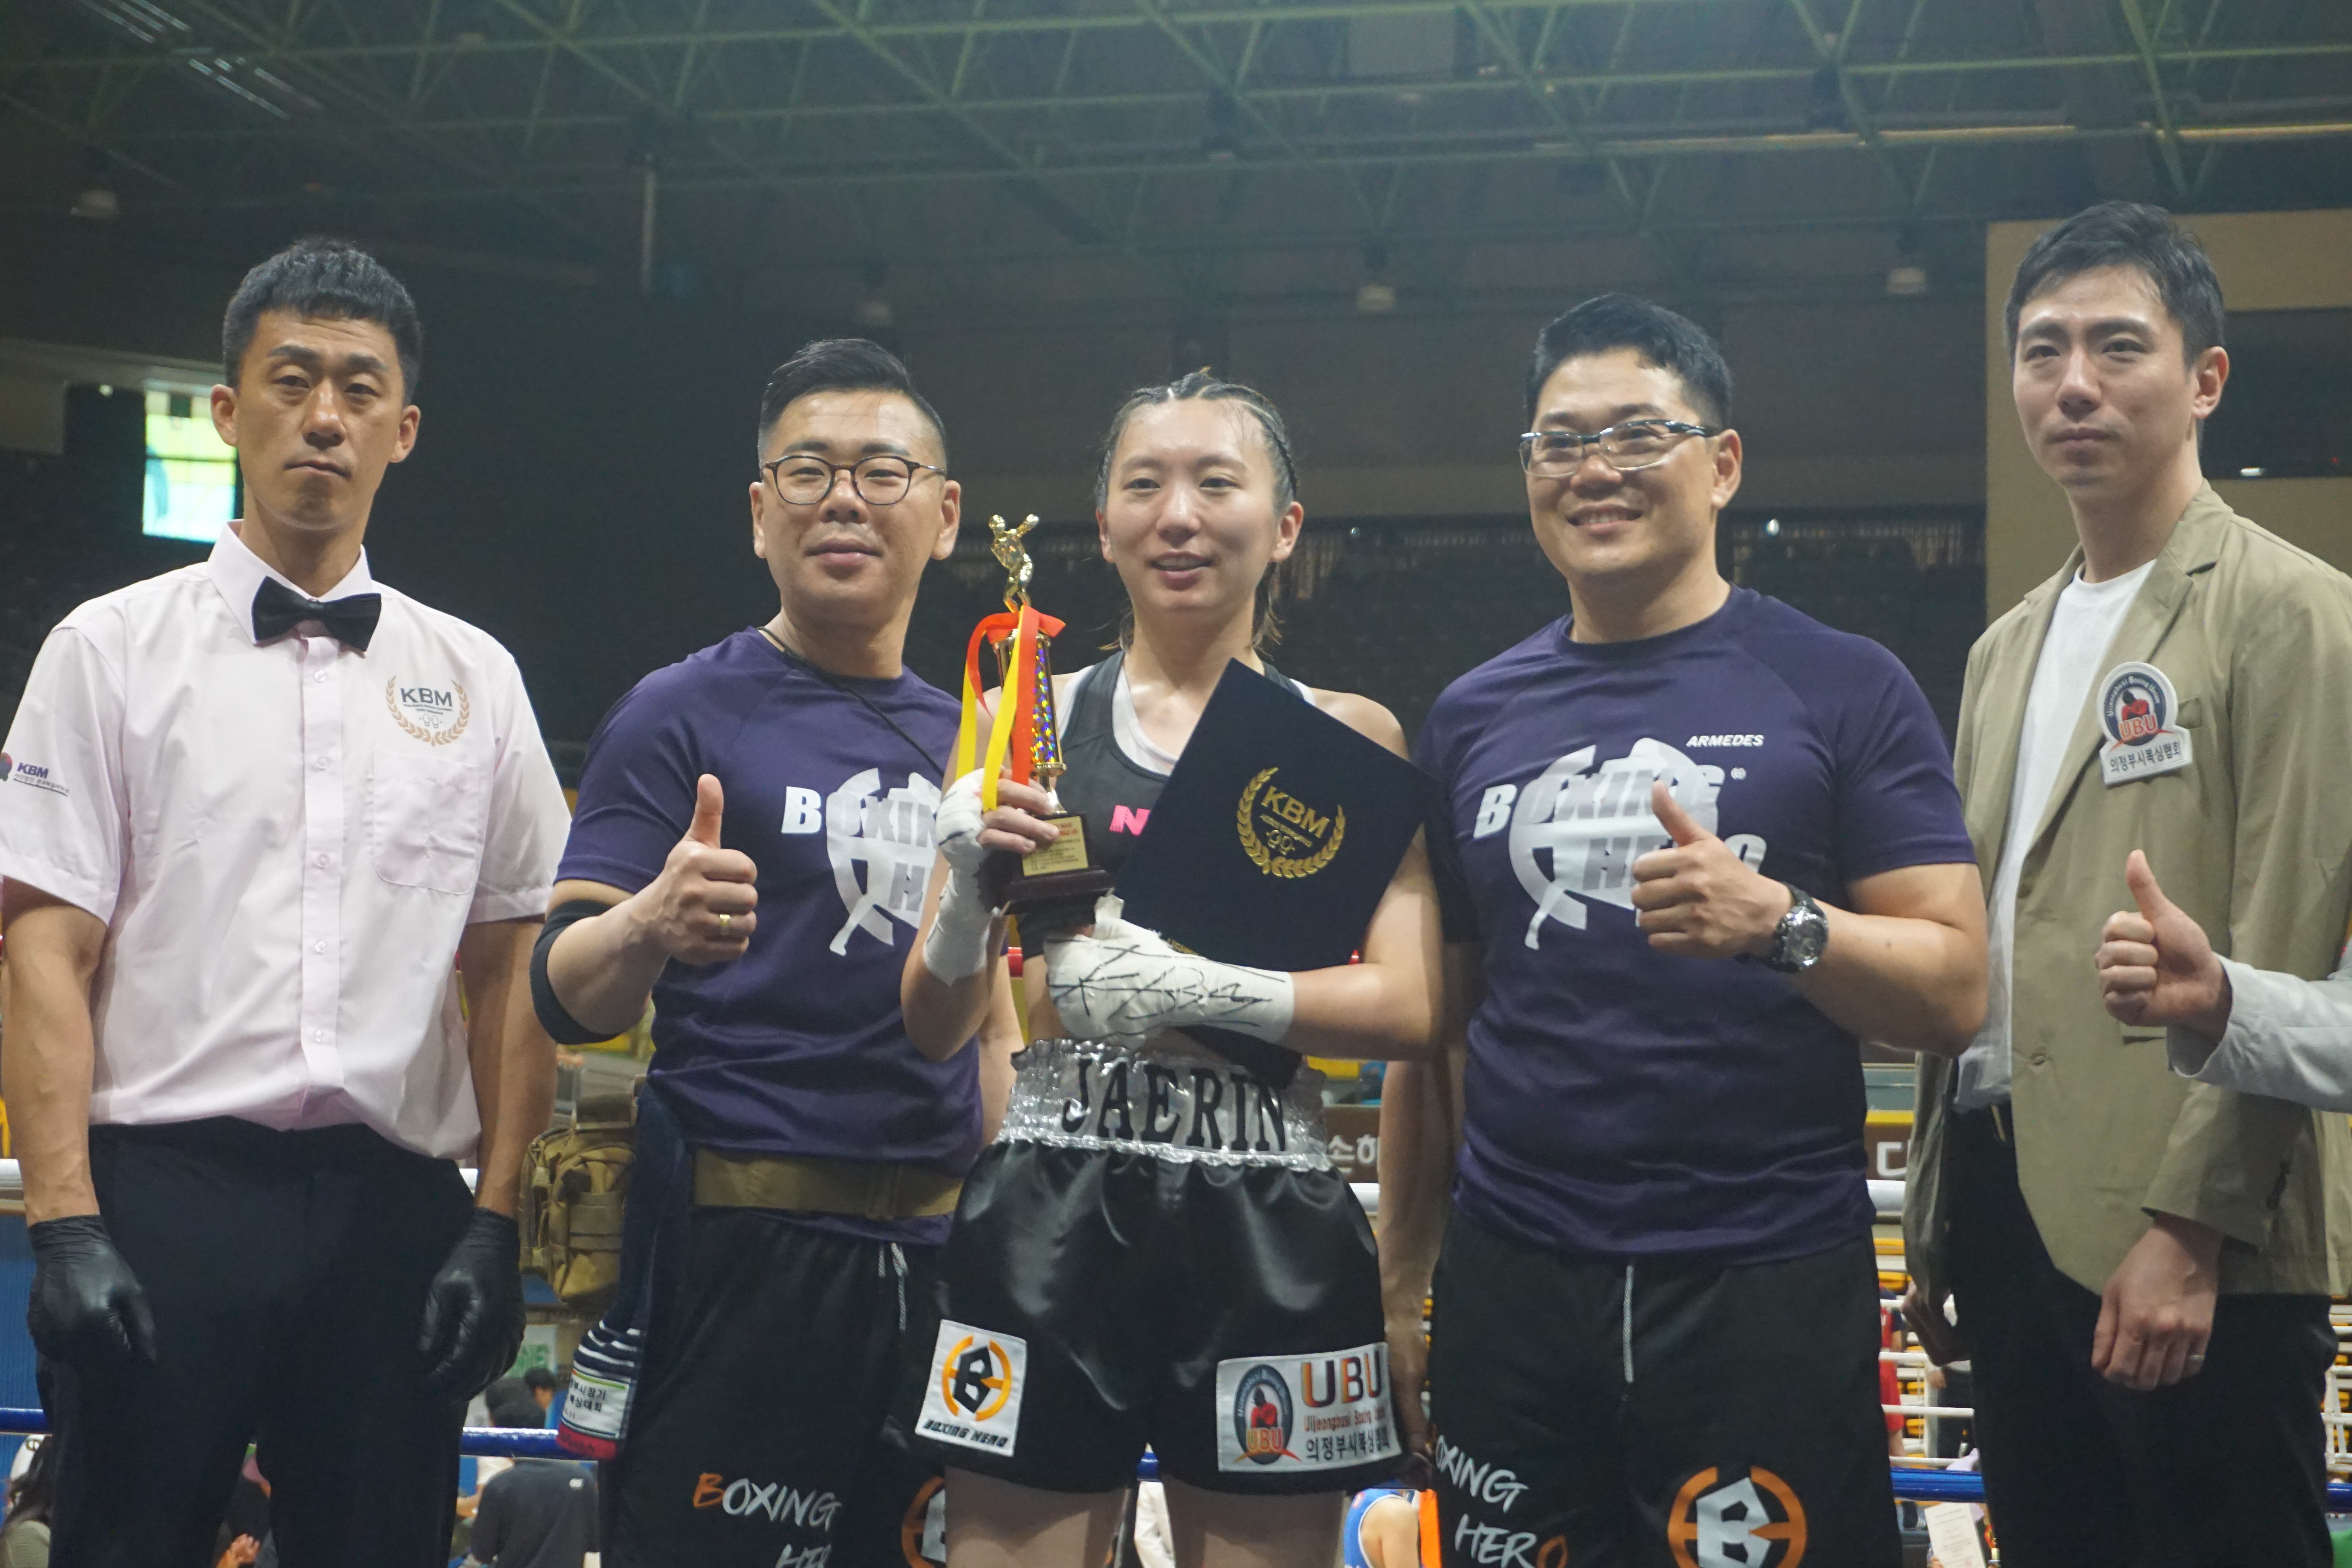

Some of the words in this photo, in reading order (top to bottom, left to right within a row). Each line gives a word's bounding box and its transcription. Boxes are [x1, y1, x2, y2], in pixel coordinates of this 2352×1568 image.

[400, 688, 452, 707] KBM
[1686, 734, 1765, 747] ARMEDES
[2118, 712, 2158, 740] UBU
[17, 762, 49, 779] KBM
[2110, 740, 2181, 773] 의정부시복싱협회
[1261, 786, 1330, 838] KBM
[1062, 1058, 1286, 1152] JAERIN
[1301, 1350, 1382, 1408] UBU
[923, 1419, 969, 1438] BOXING
[970, 1430, 1008, 1447] HERO
[1246, 1426, 1285, 1452] UBU
[1436, 1435, 1529, 1513] OXING
[692, 1472, 842, 1531] BOXING
[1455, 1514, 1568, 1568] HERO
